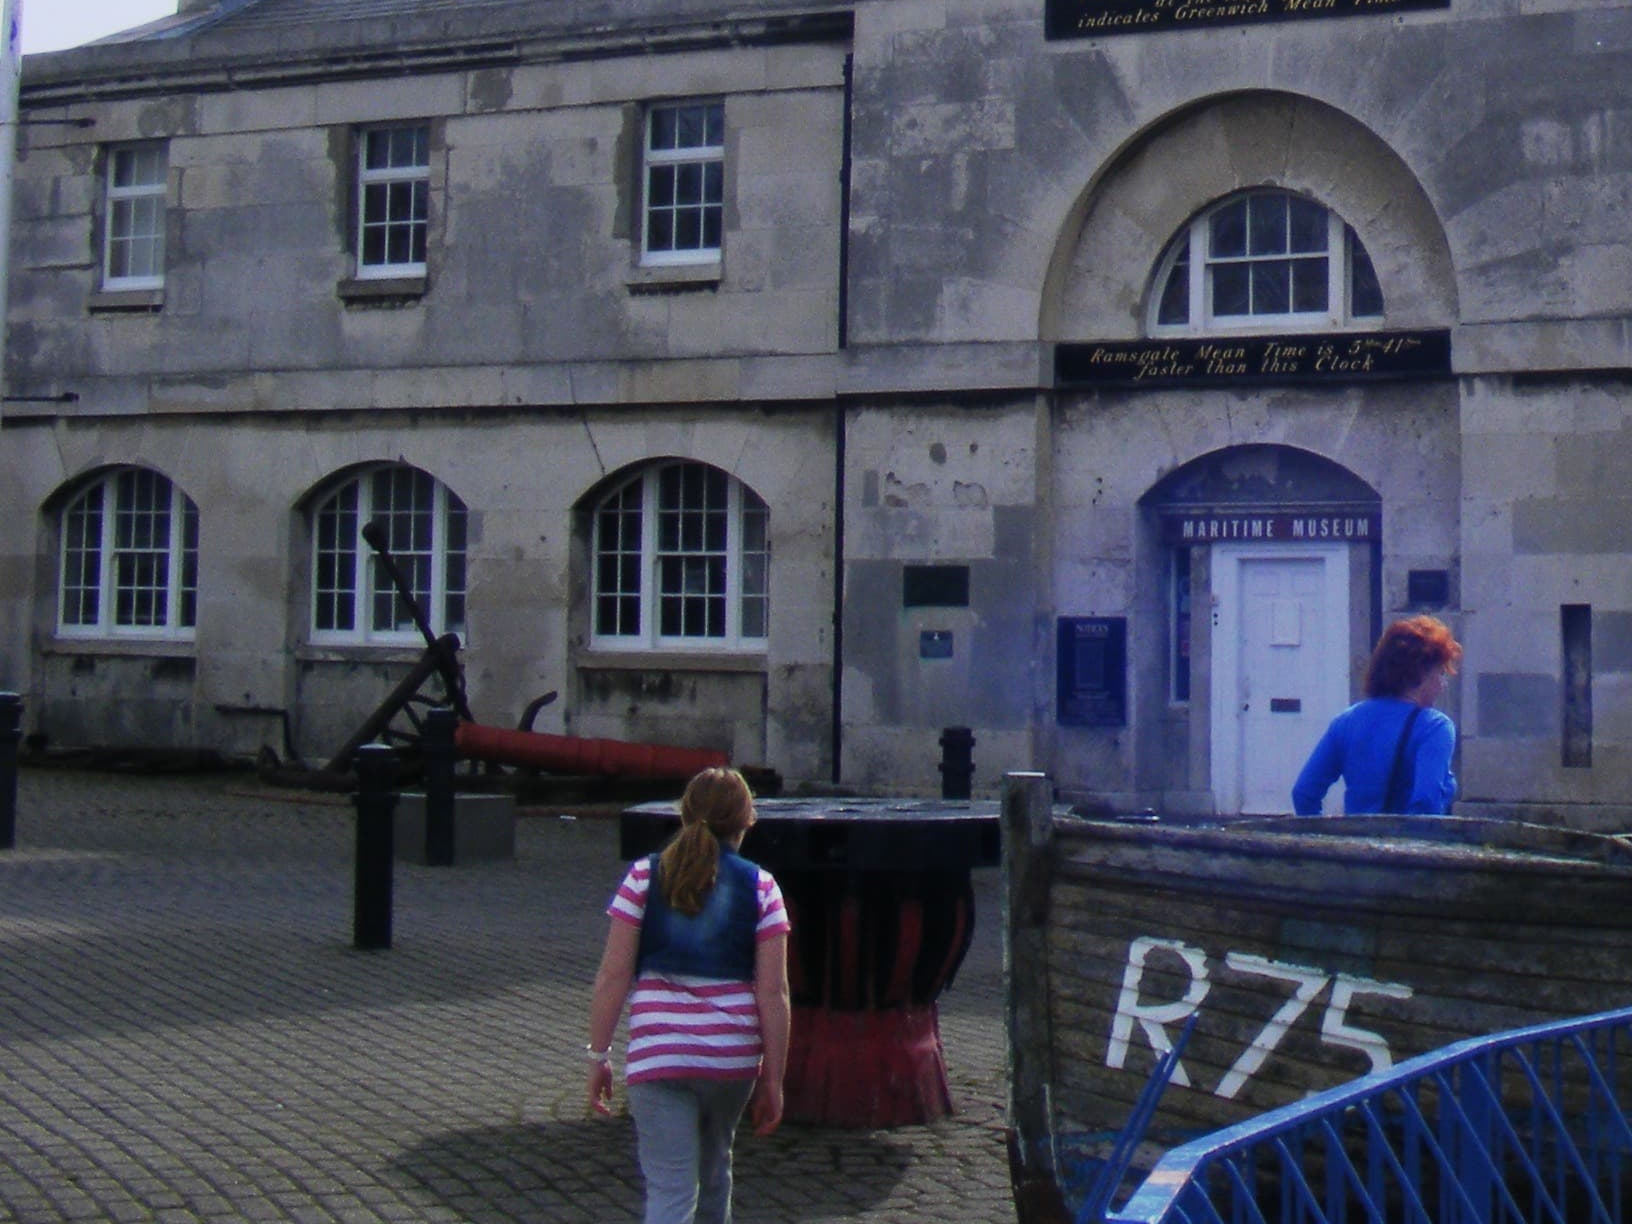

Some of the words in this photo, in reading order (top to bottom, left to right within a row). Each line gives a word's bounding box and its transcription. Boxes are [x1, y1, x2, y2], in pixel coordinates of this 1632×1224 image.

[1077, 8, 1161, 29] indicates
[1174, 0, 1269, 21] Greenwich
[1089, 346, 1181, 366] Ramsgate
[1195, 344, 1246, 361] Mean
[1263, 340, 1307, 357] Time
[1317, 339, 1334, 356] is
[1131, 360, 1194, 381] faster
[1206, 359, 1248, 375] than
[1260, 356, 1298, 373] this
[1315, 353, 1375, 372] Clock
[1183, 519, 1274, 539] MARITIME
[1292, 518, 1370, 537] MUSEUM
